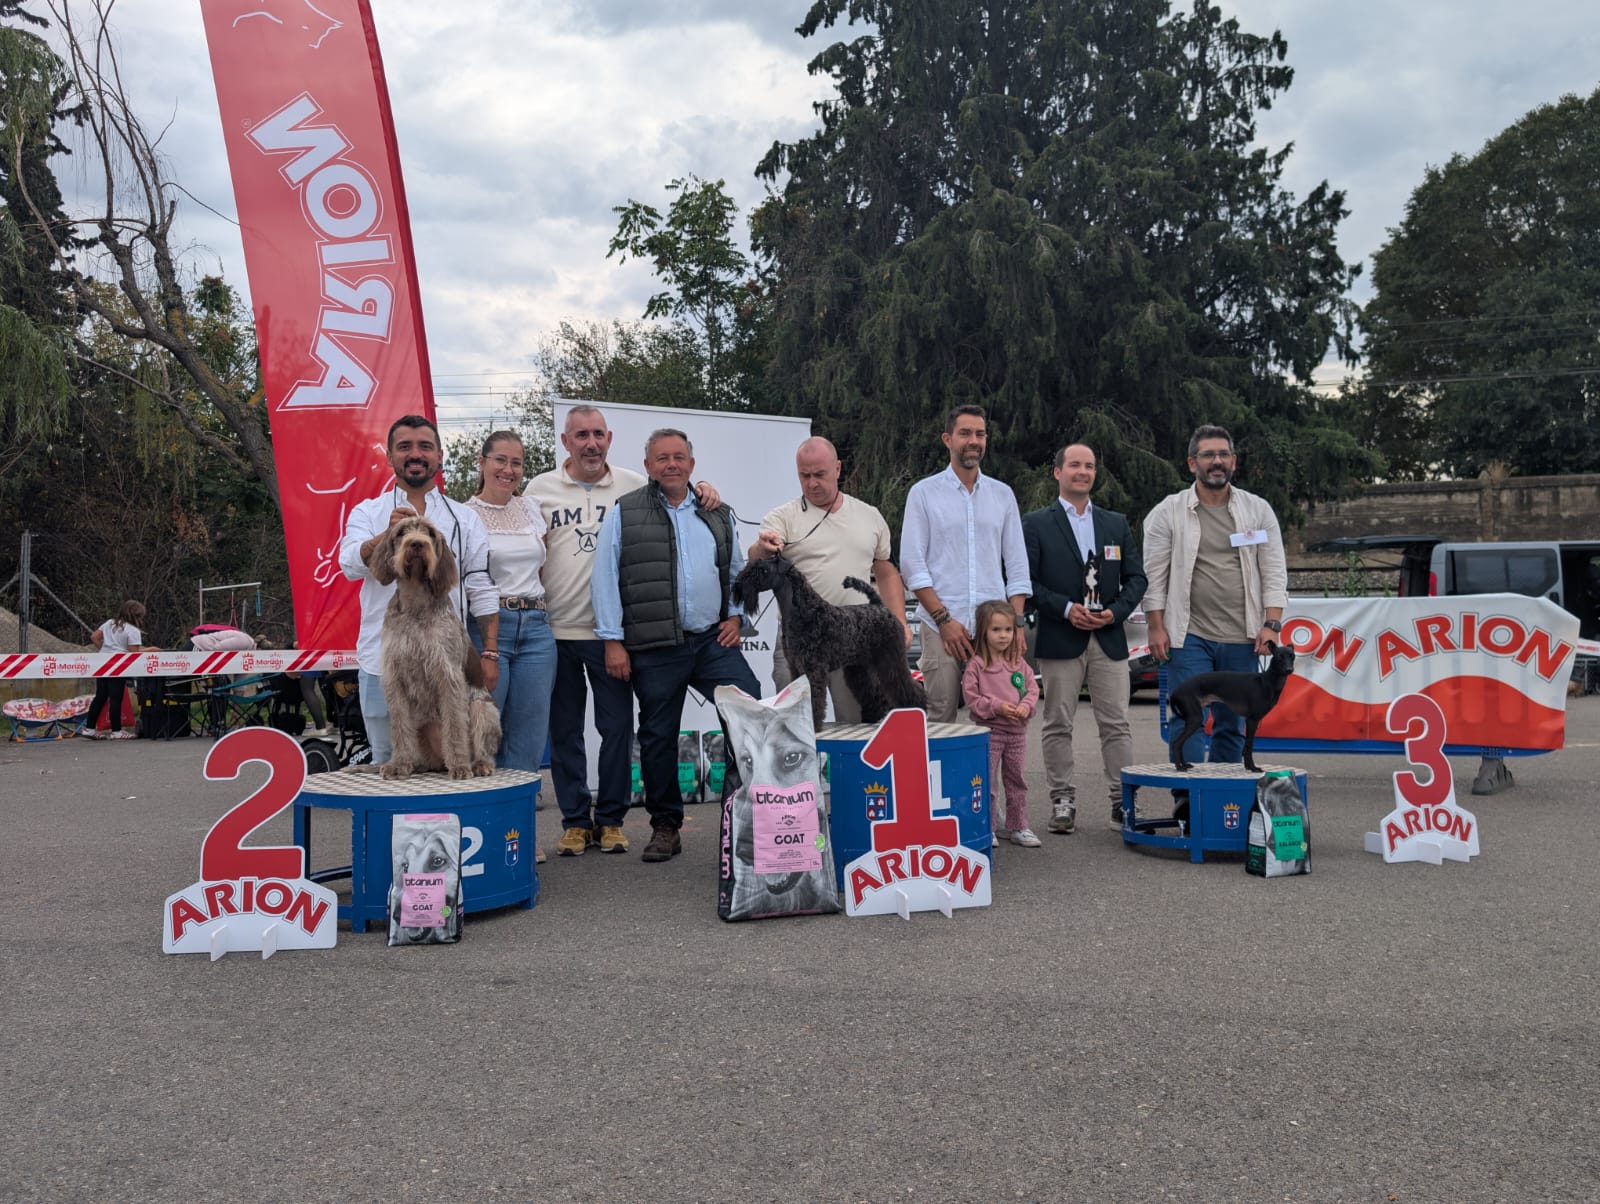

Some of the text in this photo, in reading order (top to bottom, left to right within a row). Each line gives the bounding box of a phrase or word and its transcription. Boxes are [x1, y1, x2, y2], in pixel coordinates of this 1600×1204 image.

[1279, 611, 1575, 682] ON ARION
[861, 708, 958, 852] 1
[1386, 694, 1452, 807] 3
[202, 728, 306, 881] 2
[756, 791, 814, 805] titanium
[774, 833, 805, 845] COAT
[1385, 808, 1473, 854] ARION
[404, 878, 443, 887] titanium
[848, 848, 985, 908] ARION
[168, 880, 331, 943] ARION
